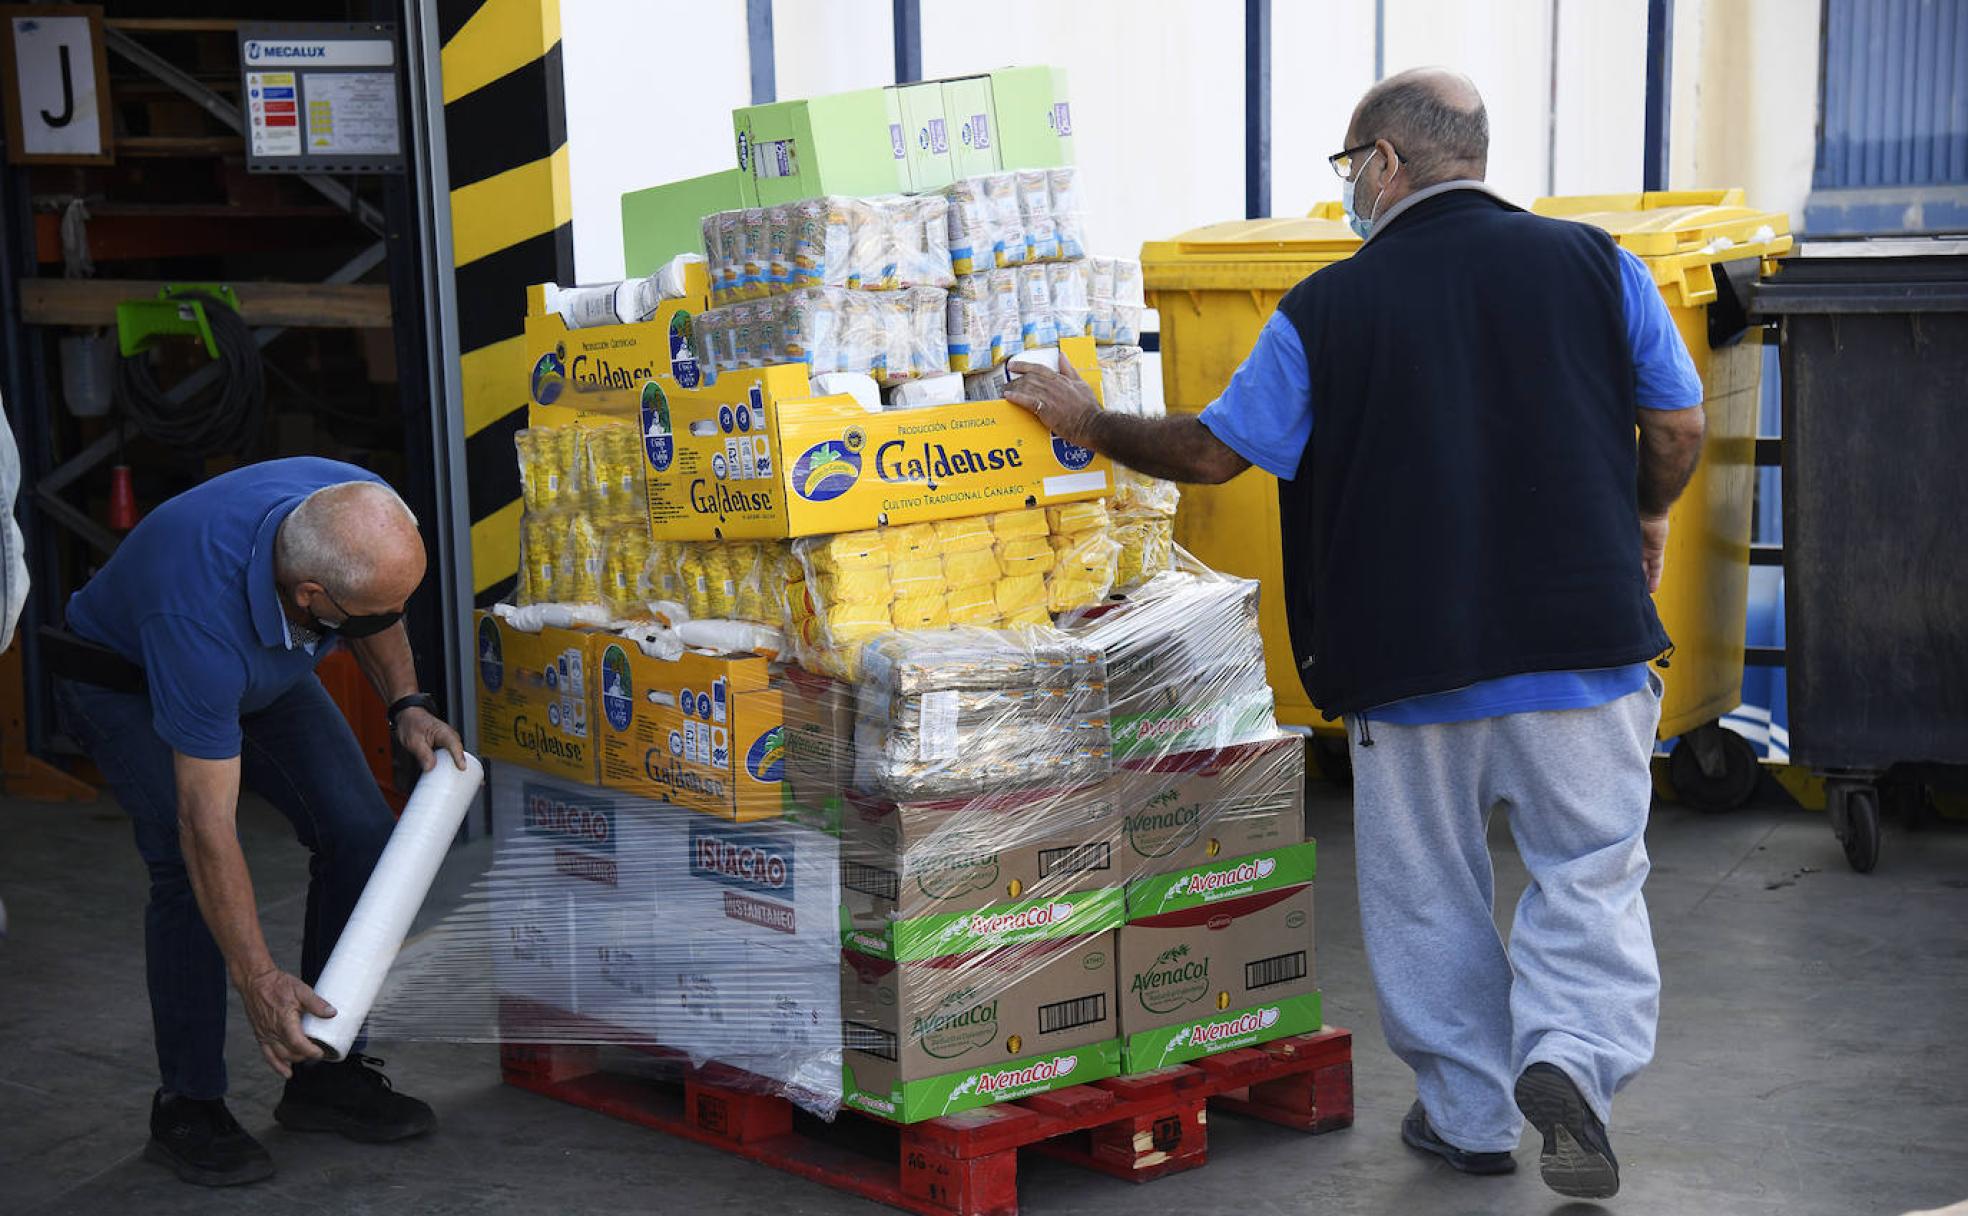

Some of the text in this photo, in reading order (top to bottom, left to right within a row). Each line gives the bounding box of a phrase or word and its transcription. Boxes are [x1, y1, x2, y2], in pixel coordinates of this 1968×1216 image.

[264, 46, 325, 57] MECALUX
[40, 45, 73, 128] J
[950, 417, 997, 430] CERTIFICADA
[690, 479, 773, 523] Galdense
[882, 499, 921, 511] CULTIVO
[923, 490, 982, 506] TRADICIONAL
[696, 836, 787, 889] ISLACAO
[1187, 859, 1260, 896] AvenaCol
[968, 902, 1055, 937] AvenaCol
[1131, 956, 1209, 994] AvenaCol
[911, 999, 999, 1038] AvenaCol
[1190, 1009, 1264, 1047] AvenaCol
[975, 1056, 1060, 1095] AvenaCol
